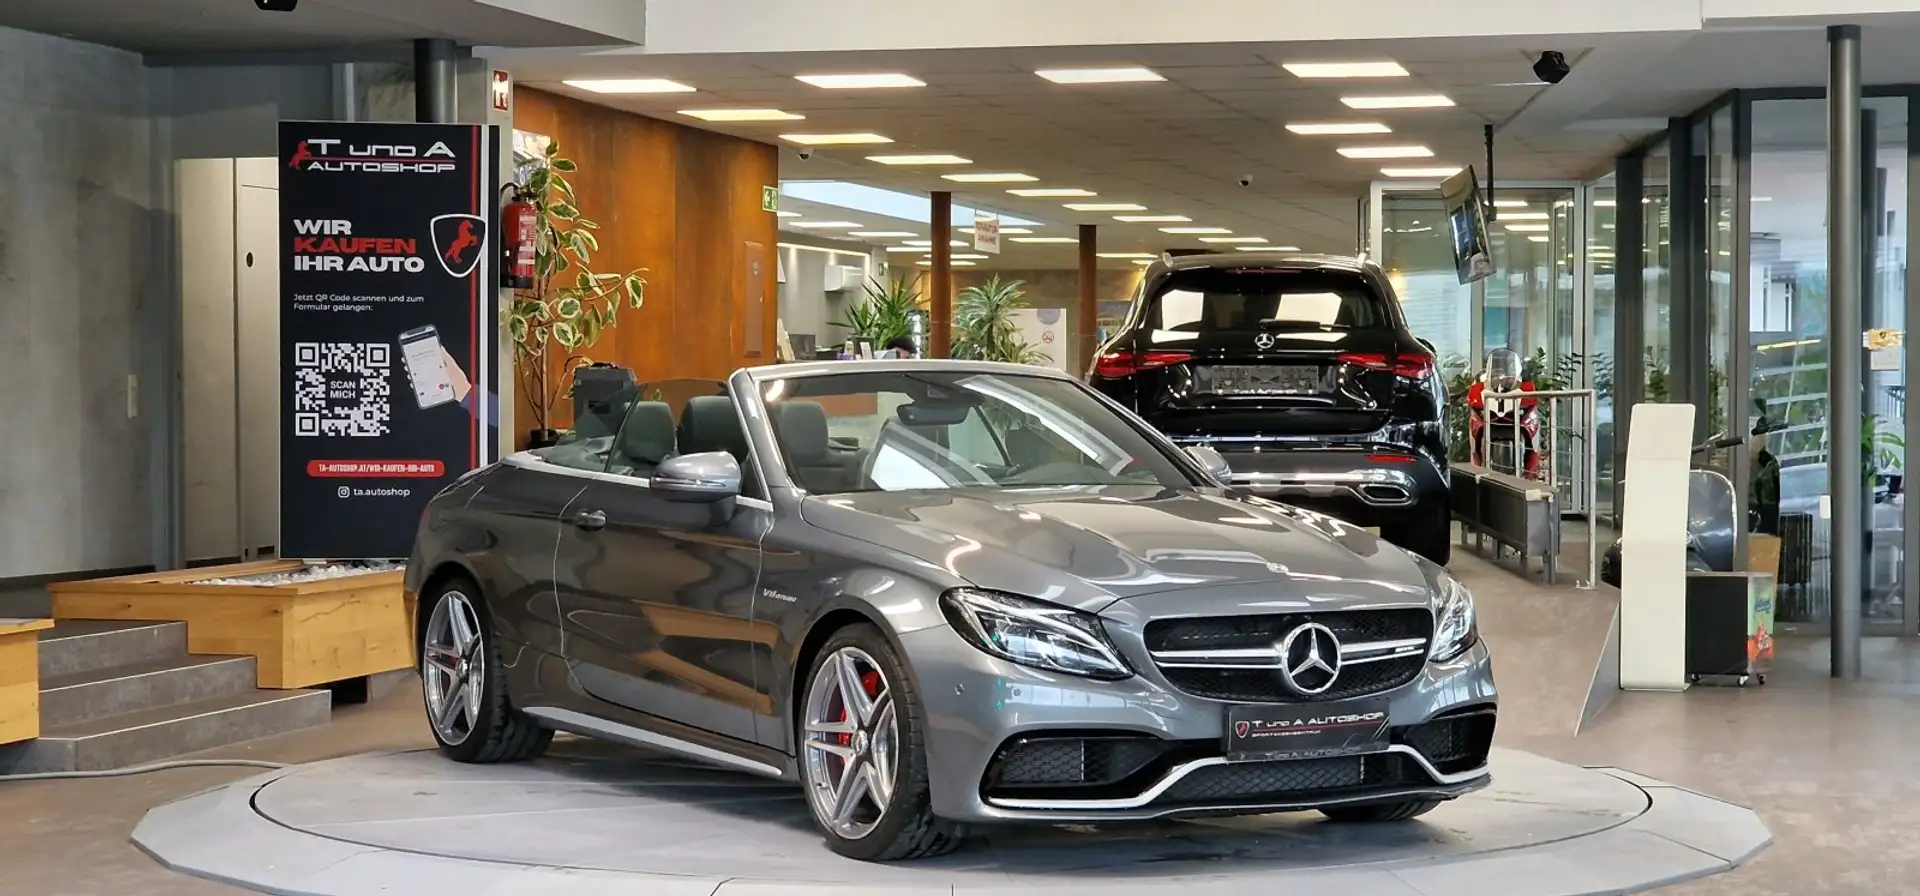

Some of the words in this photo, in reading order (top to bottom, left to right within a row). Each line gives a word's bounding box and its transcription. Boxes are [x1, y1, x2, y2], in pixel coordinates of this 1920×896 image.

[307, 139, 341, 155] T
[423, 141, 456, 158] A
[307, 160, 456, 173] AUTOSHOP
[293, 219, 352, 235] WIR
[293, 237, 416, 254] KAUFEN
[293, 255, 344, 271] IHR
[347, 256, 425, 272] AUTO
[293, 293, 314, 302] Jetzt
[315, 293, 328, 302] QR
[329, 293, 351, 302] Code
[388, 294, 405, 302] und
[293, 303, 331, 311] Formular
[332, 303, 373, 312] gelangen:
[330, 380, 356, 390] SCAN
[330, 390, 356, 399] MICH
[353, 486, 411, 497] ta.autoshop
[1308, 712, 1384, 724] AUTOSHOP
